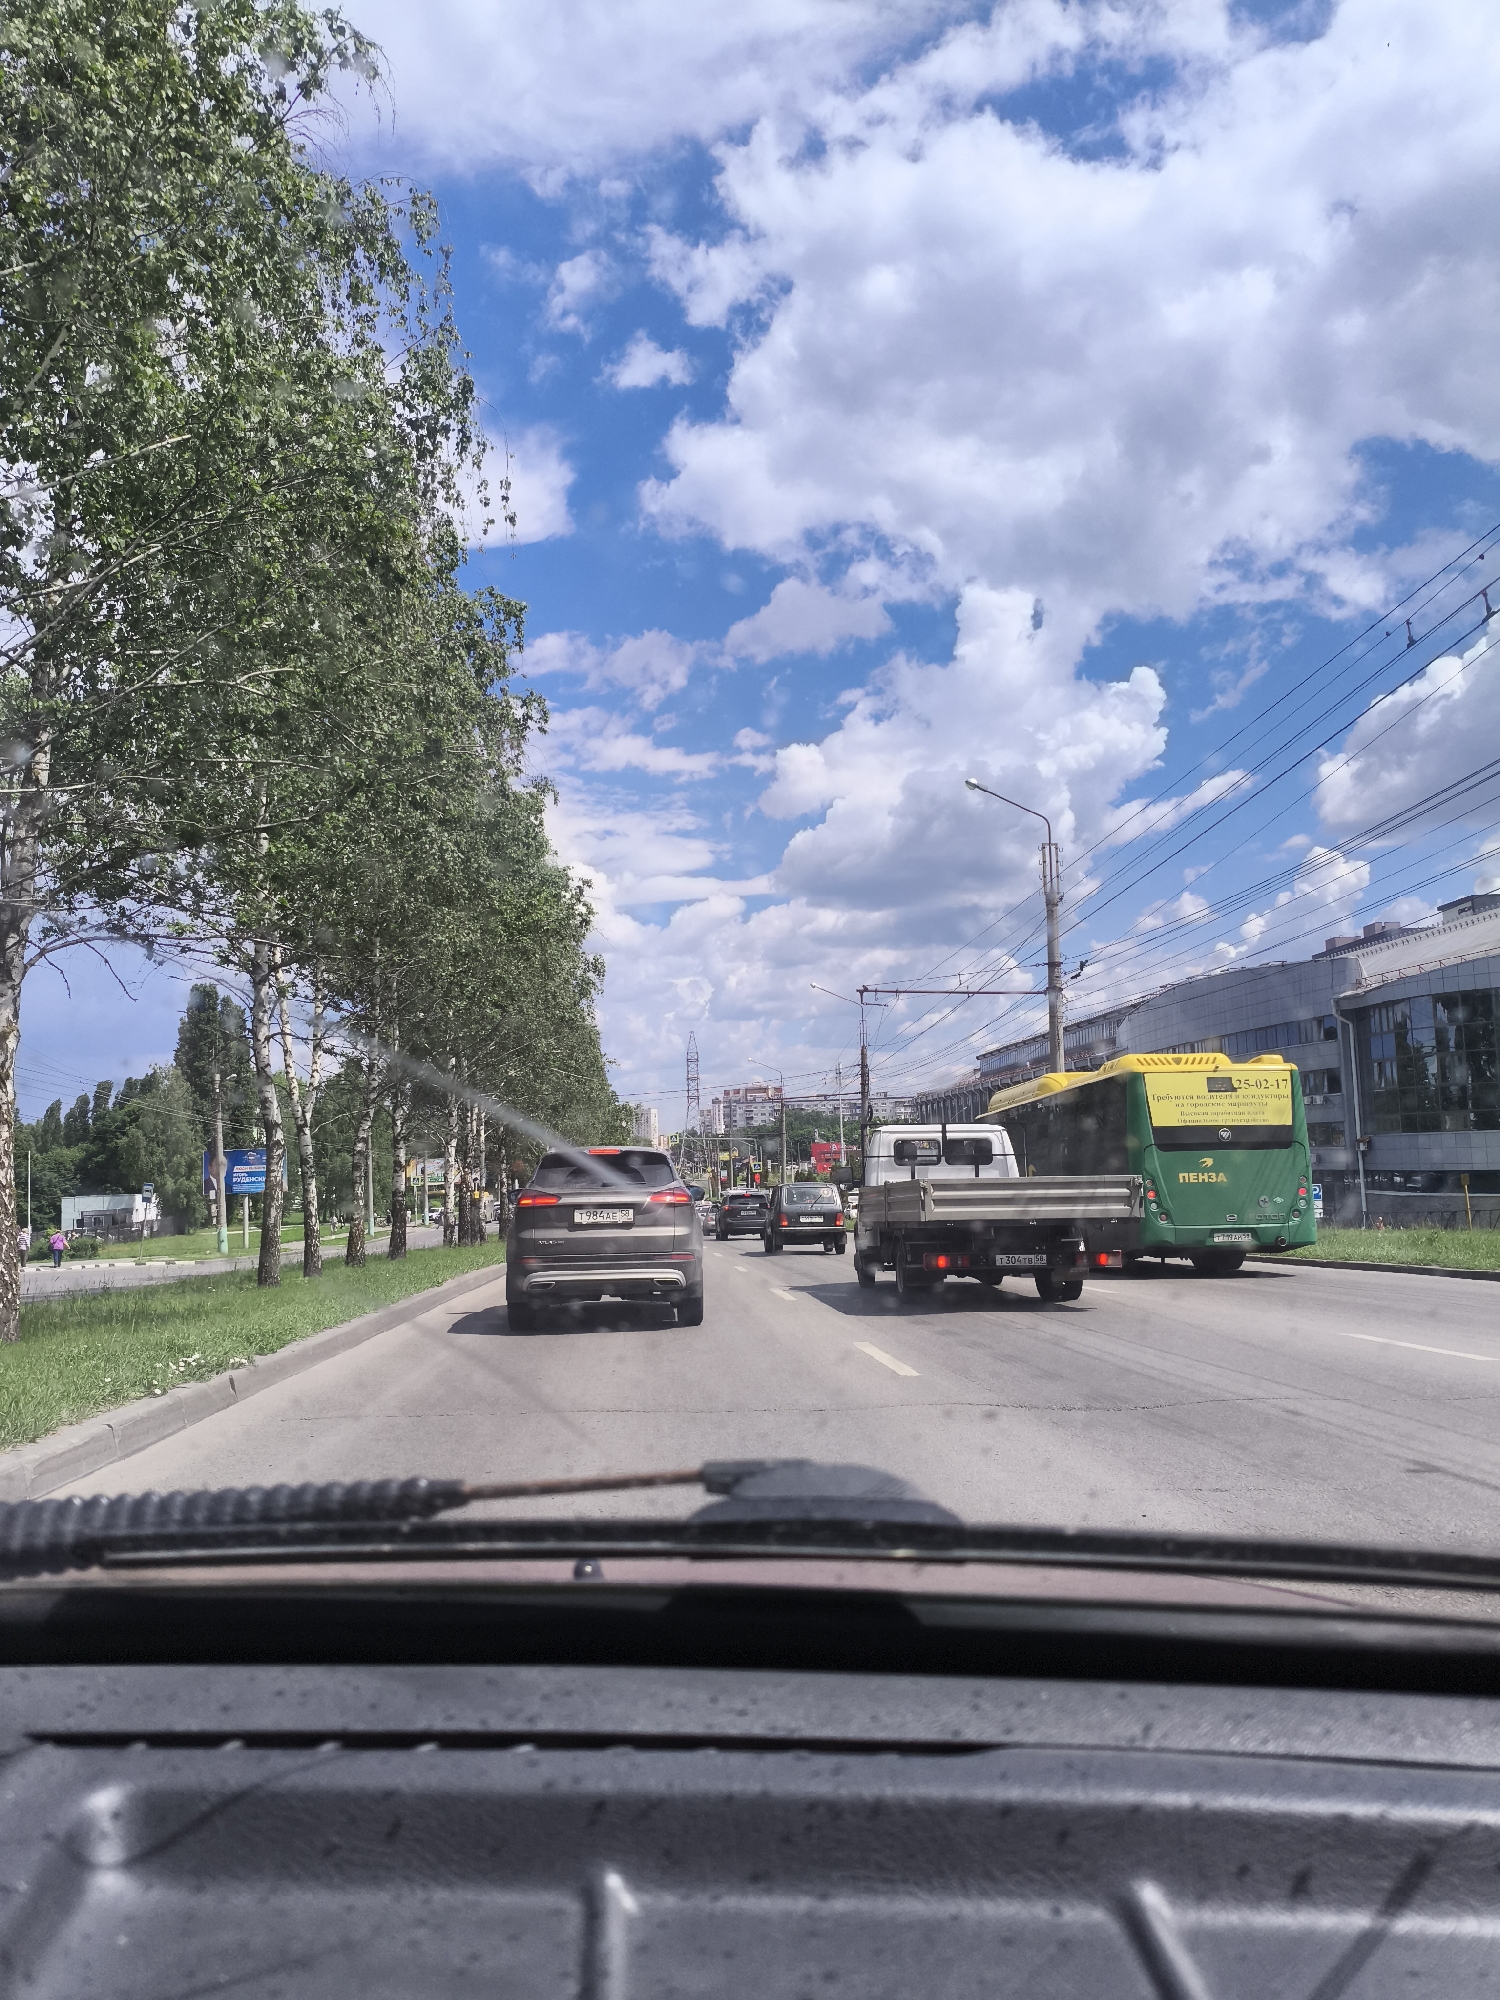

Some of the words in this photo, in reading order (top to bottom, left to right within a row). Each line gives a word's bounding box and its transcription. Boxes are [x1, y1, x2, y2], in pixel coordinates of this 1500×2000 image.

[1236, 1079, 1288, 1089] 25-02-17
[1151, 1093, 1193, 1102] Требуются
[1242, 1093, 1289, 1101] кондукторы
[1178, 1172, 1227, 1183] ПЕНЗА
